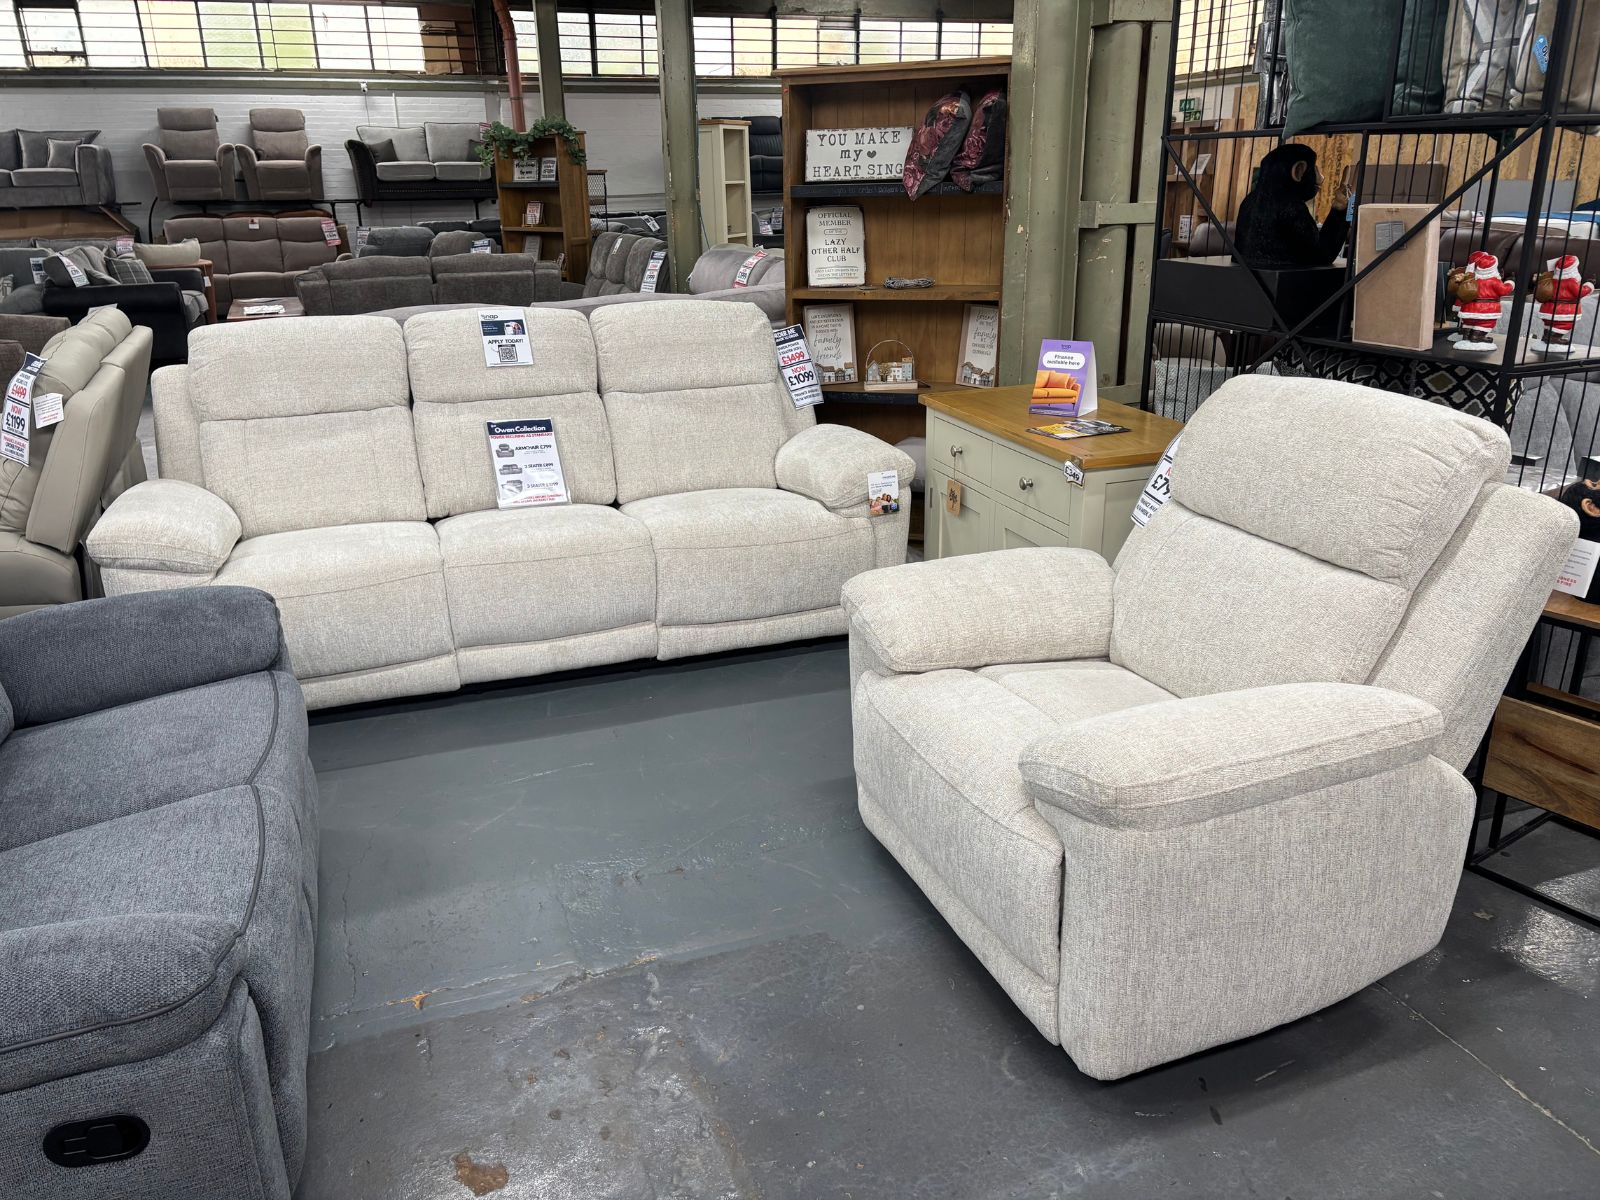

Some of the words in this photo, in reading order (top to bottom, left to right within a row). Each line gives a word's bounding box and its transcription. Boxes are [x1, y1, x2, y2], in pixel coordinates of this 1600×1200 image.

[817, 134, 847, 146] YOU
[855, 131, 900, 145] MAKE
[840, 149, 863, 161] my
[813, 165, 861, 177] HEART
[868, 164, 903, 175] SING
[814, 333, 842, 349] family
[974, 327, 996, 344] family
[782, 351, 805, 365] £1499
[816, 349, 842, 362] friends
[791, 365, 806, 374] NOW
[788, 371, 814, 386] £1099
[11, 404, 22, 416] NOW
[6, 413, 25, 431] £1199
[1065, 466, 1080, 481] £349
